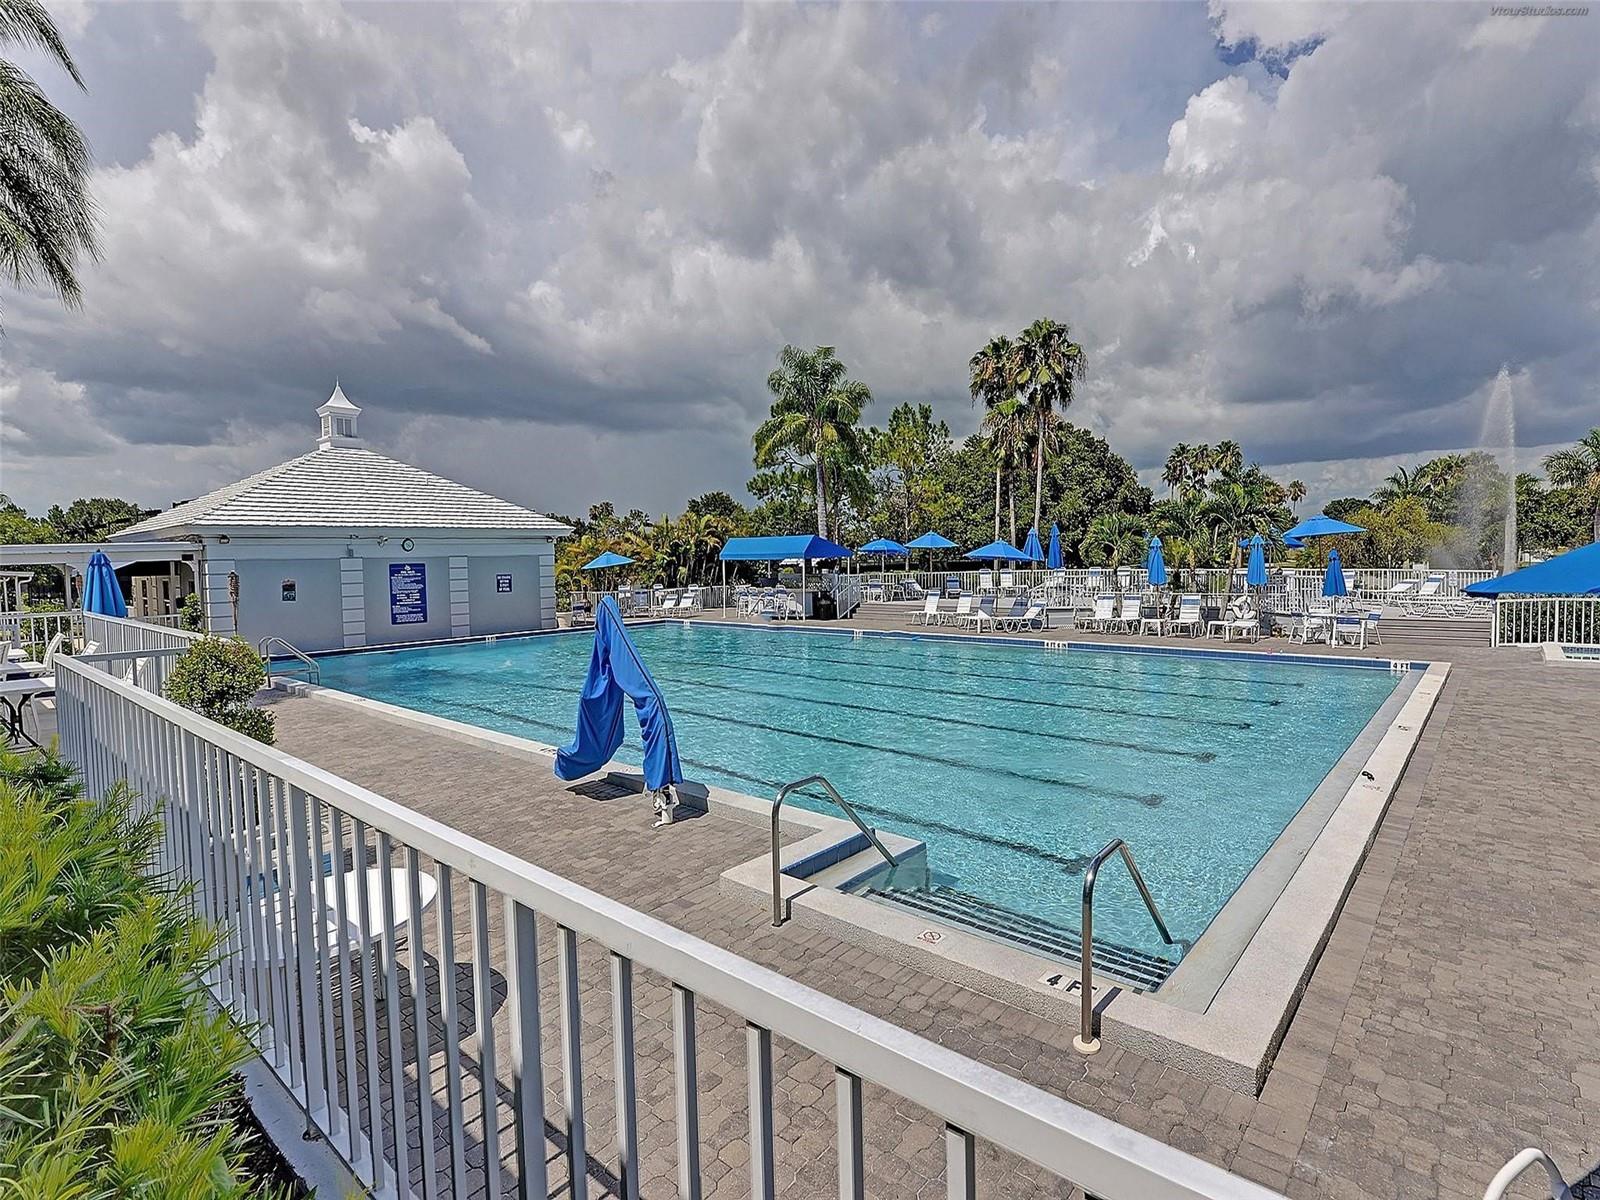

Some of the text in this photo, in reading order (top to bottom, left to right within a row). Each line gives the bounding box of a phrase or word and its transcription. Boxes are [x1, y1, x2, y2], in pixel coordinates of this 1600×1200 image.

[1392, 661, 1409, 670] 4 FT
[1046, 974, 1064, 987] 4
